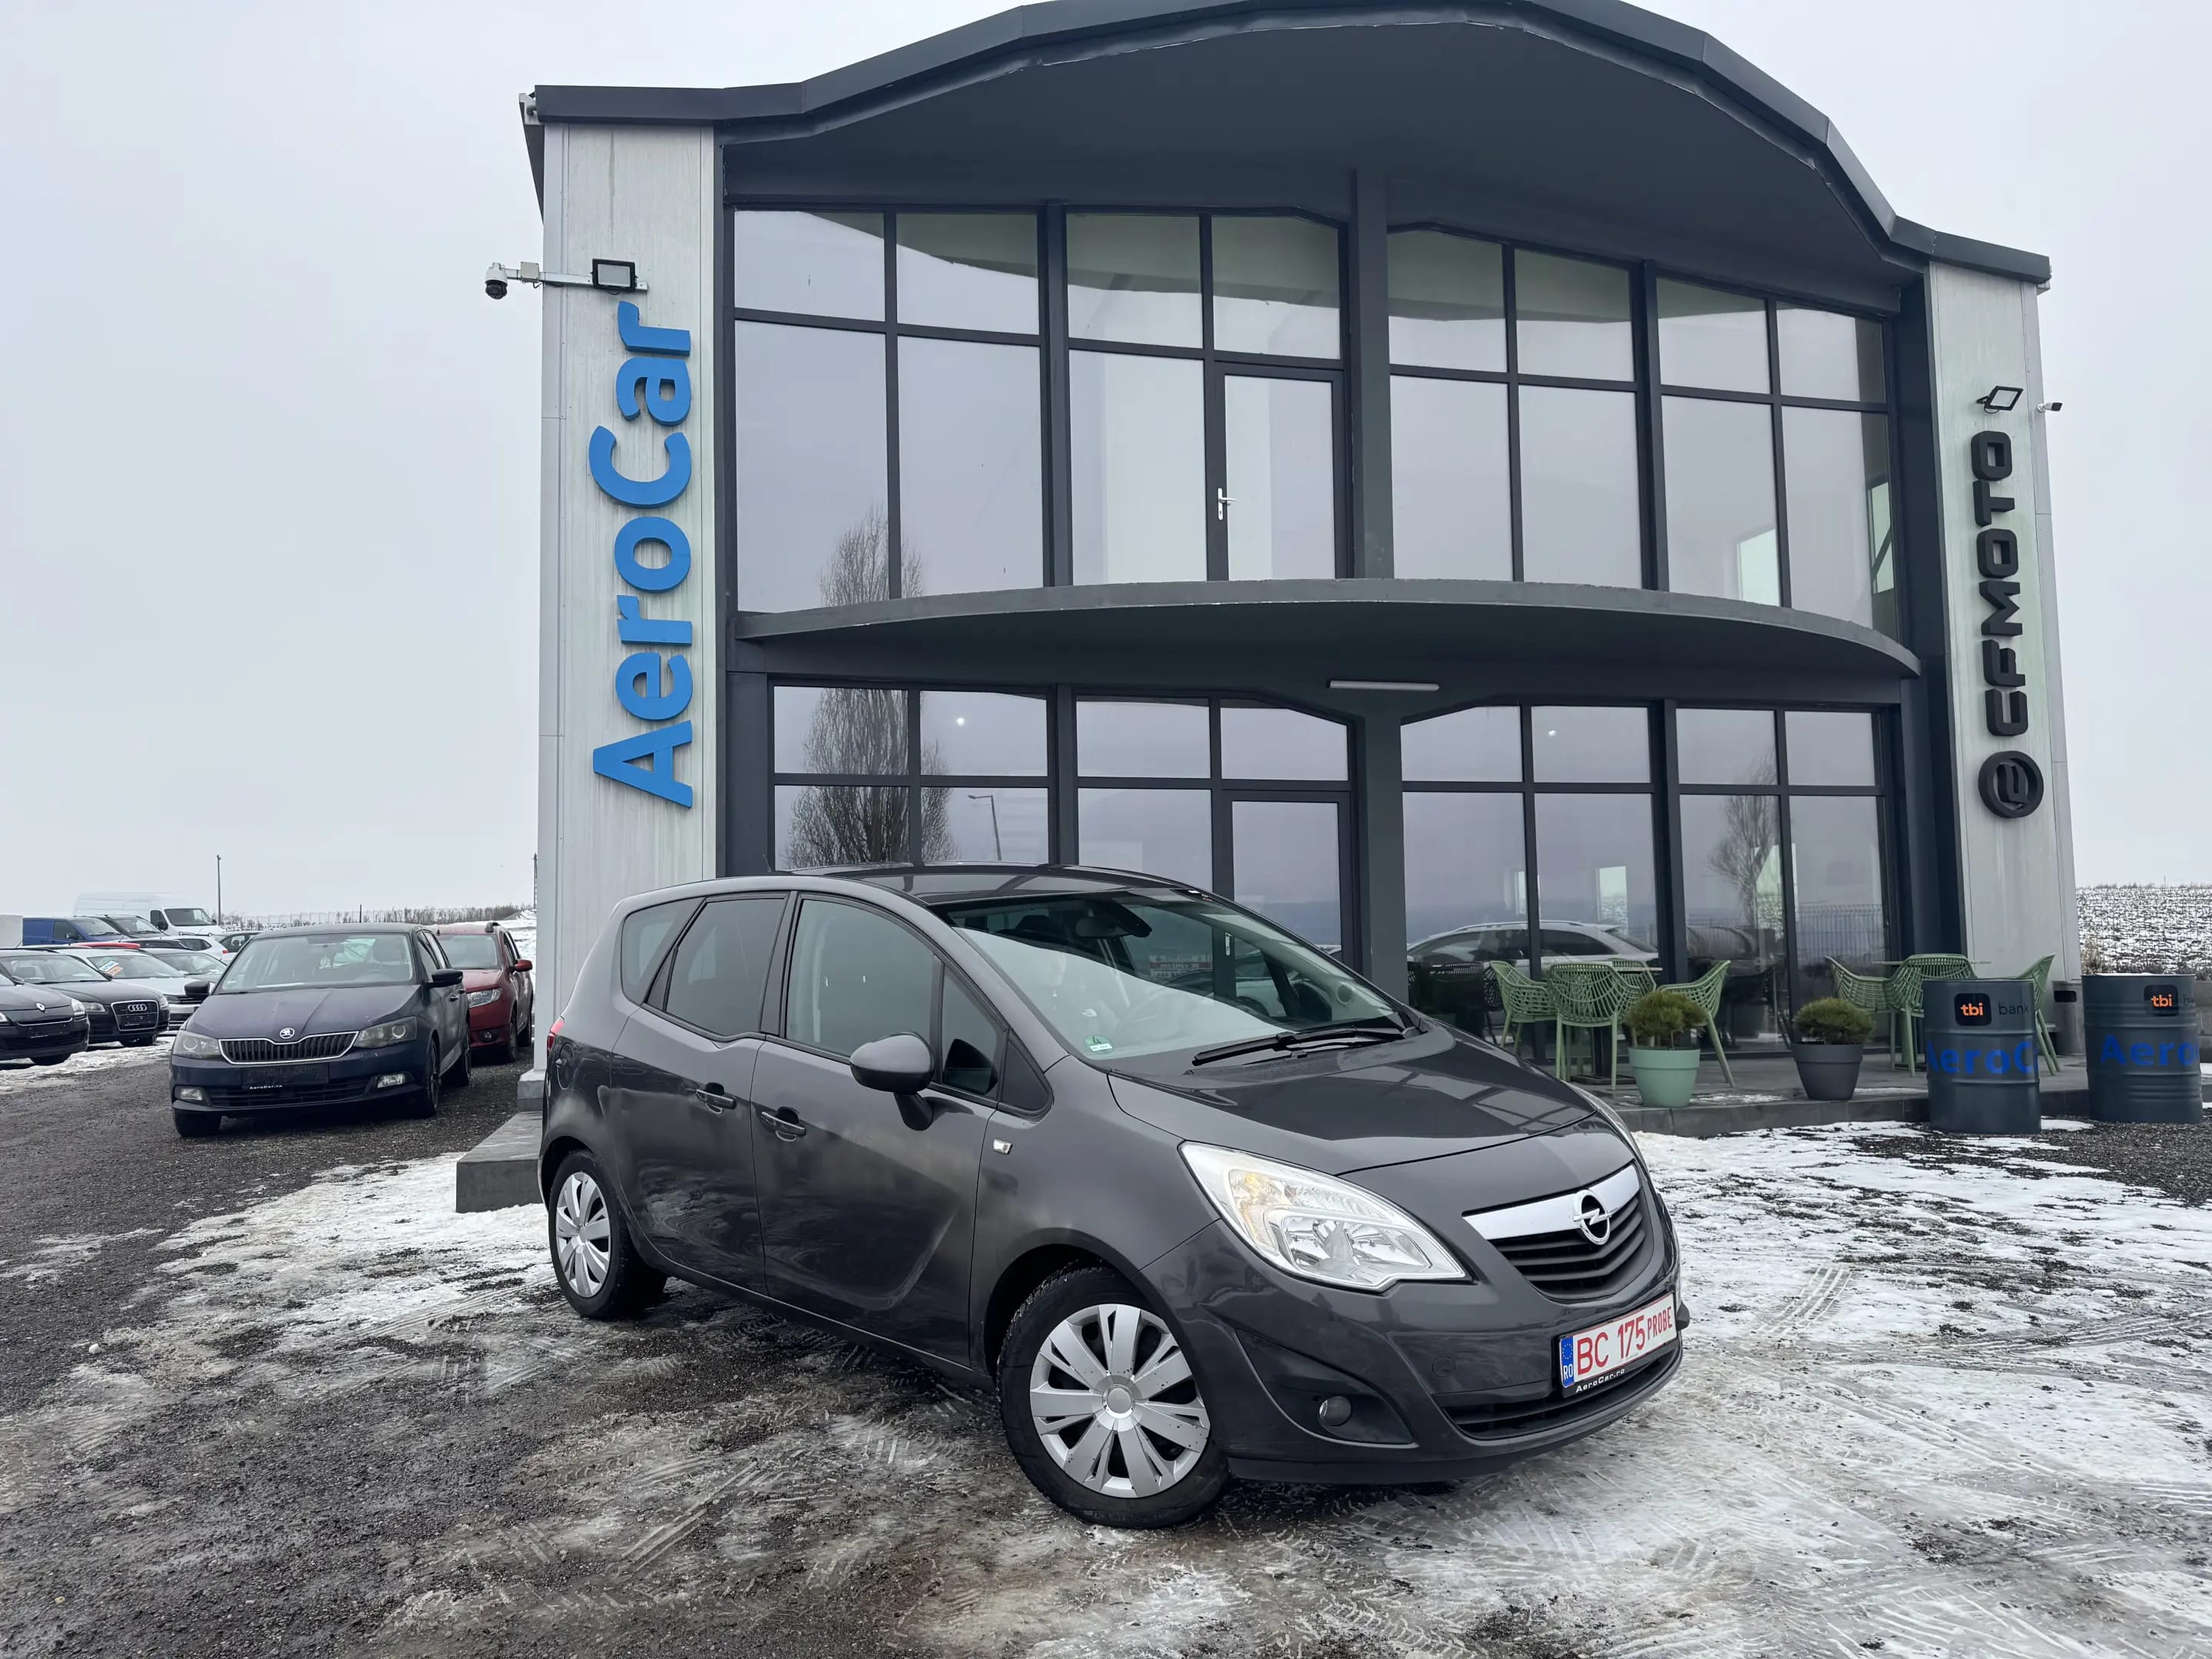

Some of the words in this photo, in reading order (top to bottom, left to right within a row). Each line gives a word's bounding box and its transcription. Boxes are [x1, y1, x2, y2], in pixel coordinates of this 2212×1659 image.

[588, 301, 693, 809] AeroCar
[1970, 430, 2028, 737] CFMOTO
[1960, 1002, 1984, 1016] tbi
[1998, 1002, 2028, 1015] bank
[2151, 994, 2173, 1008] tbi
[1577, 1331, 1609, 1376] BC
[1618, 1314, 1646, 1359] 175
[1647, 1306, 1673, 1340] PROBE
[1562, 1363, 1575, 1381] RO
[1575, 1368, 1626, 1393] AeroCar.ro
